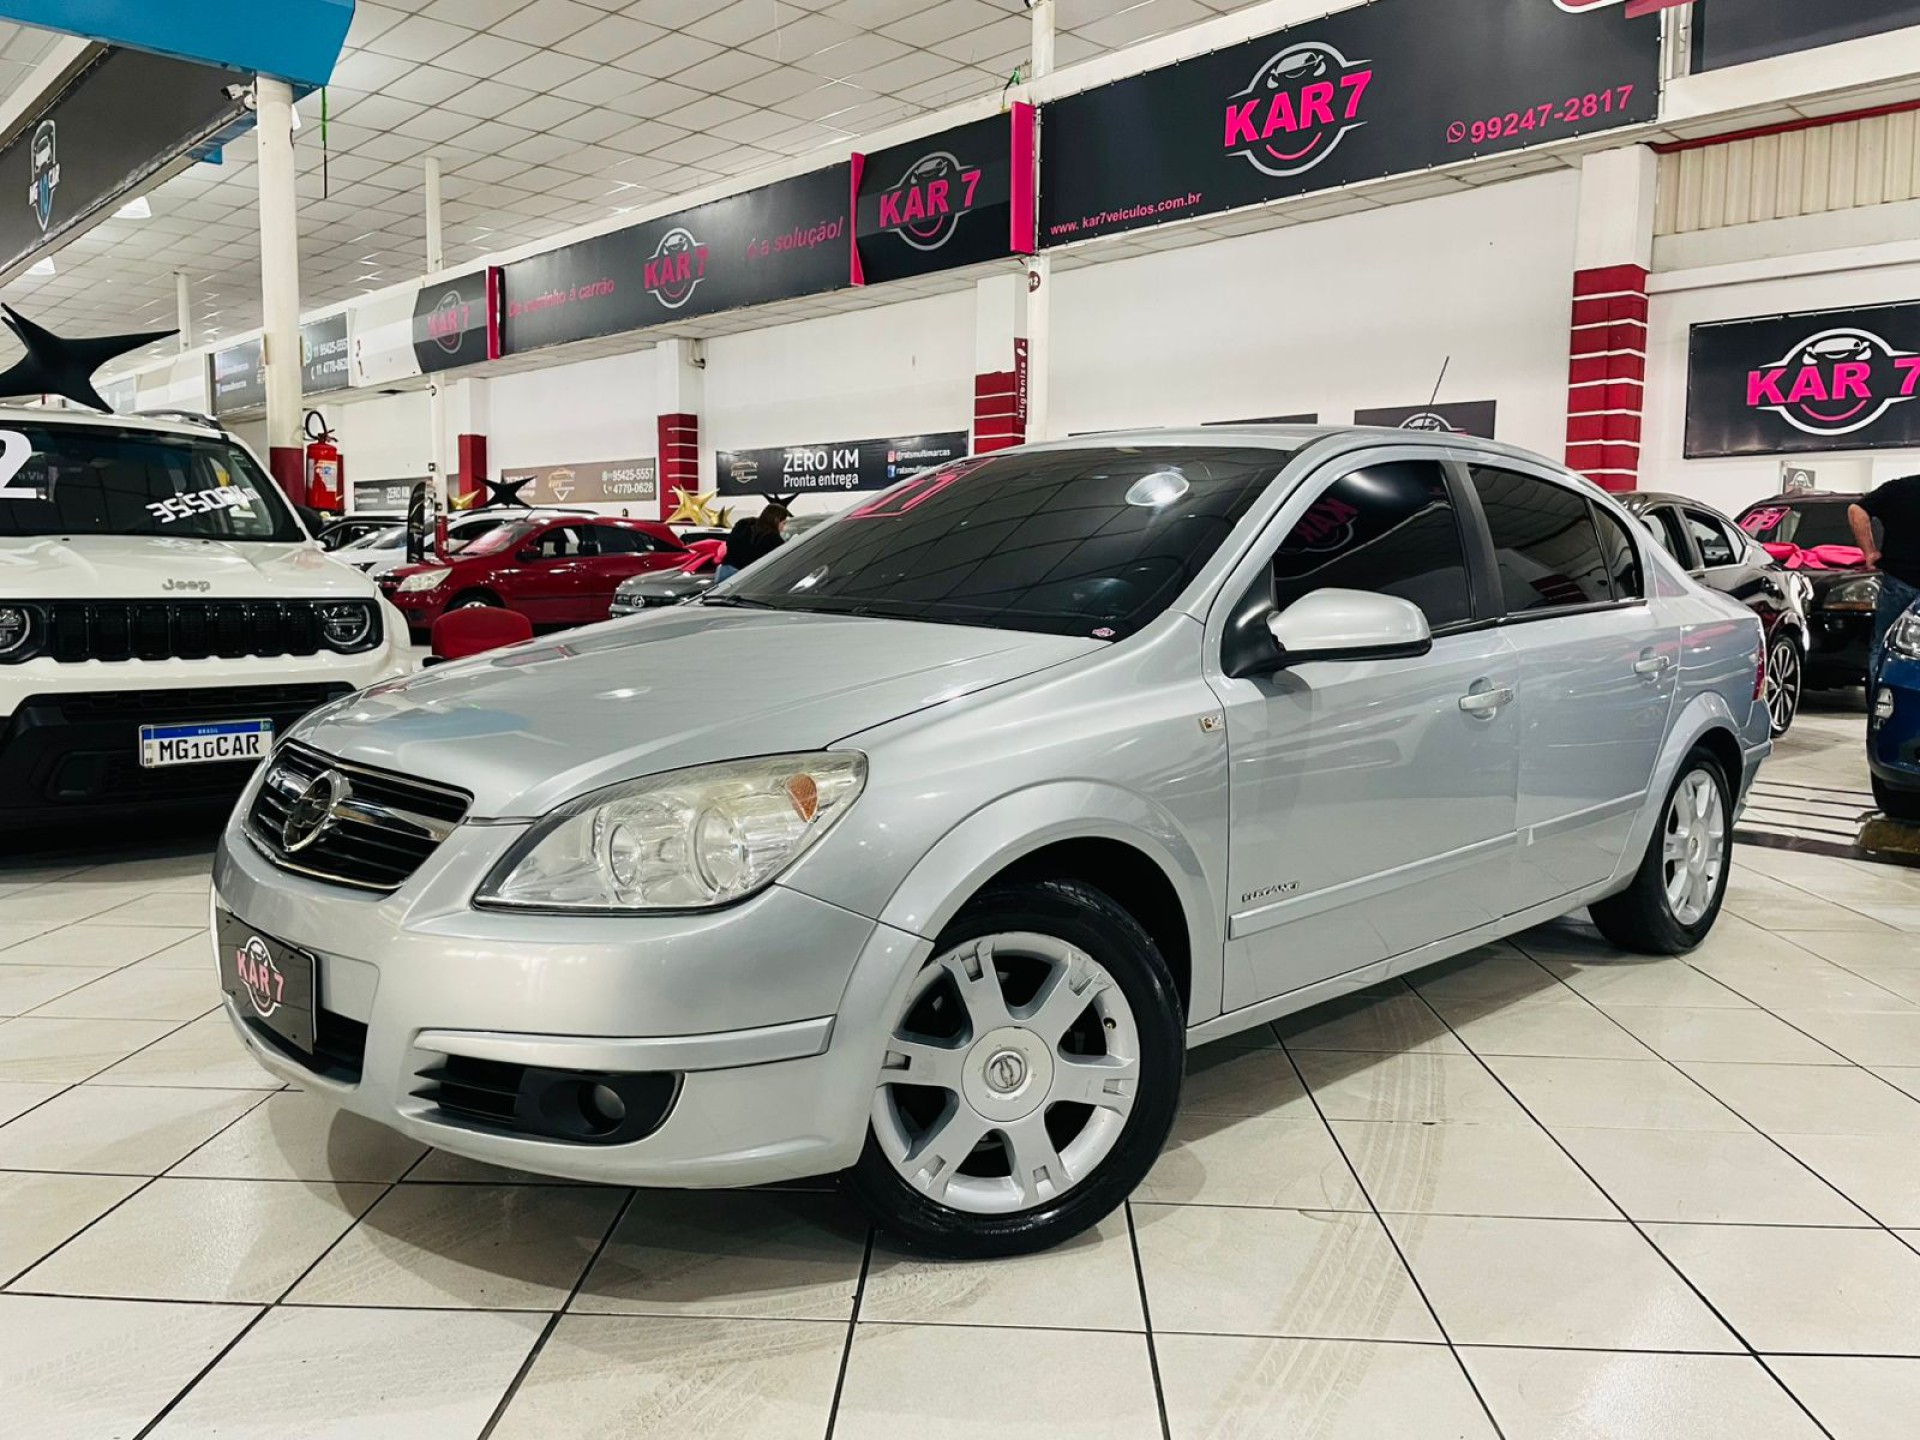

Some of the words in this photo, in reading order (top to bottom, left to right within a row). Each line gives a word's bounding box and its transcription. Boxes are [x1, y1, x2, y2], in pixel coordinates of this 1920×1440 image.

[1470, 84, 1634, 144] 99247-2817
[880, 179, 949, 228] KAR
[961, 169, 981, 208] 7
[1049, 221, 1079, 236] www.
[1082, 192, 1202, 230] kar7veiculos.com.br
[774, 215, 844, 252] solução!
[643, 250, 691, 289] KAR
[695, 245, 709, 277] 7
[1747, 361, 1872, 406] KAR
[1894, 356, 1920, 395] 7
[783, 451, 828, 472] ZERO
[833, 448, 859, 469] KM
[783, 474, 817, 488] Pronta
[818, 472, 859, 489] entrega
[162, 578, 211, 593] Jeep
[159, 734, 259, 761] MG10CAR
[236, 949, 271, 997] KAR
[273, 972, 284, 1003] 7
